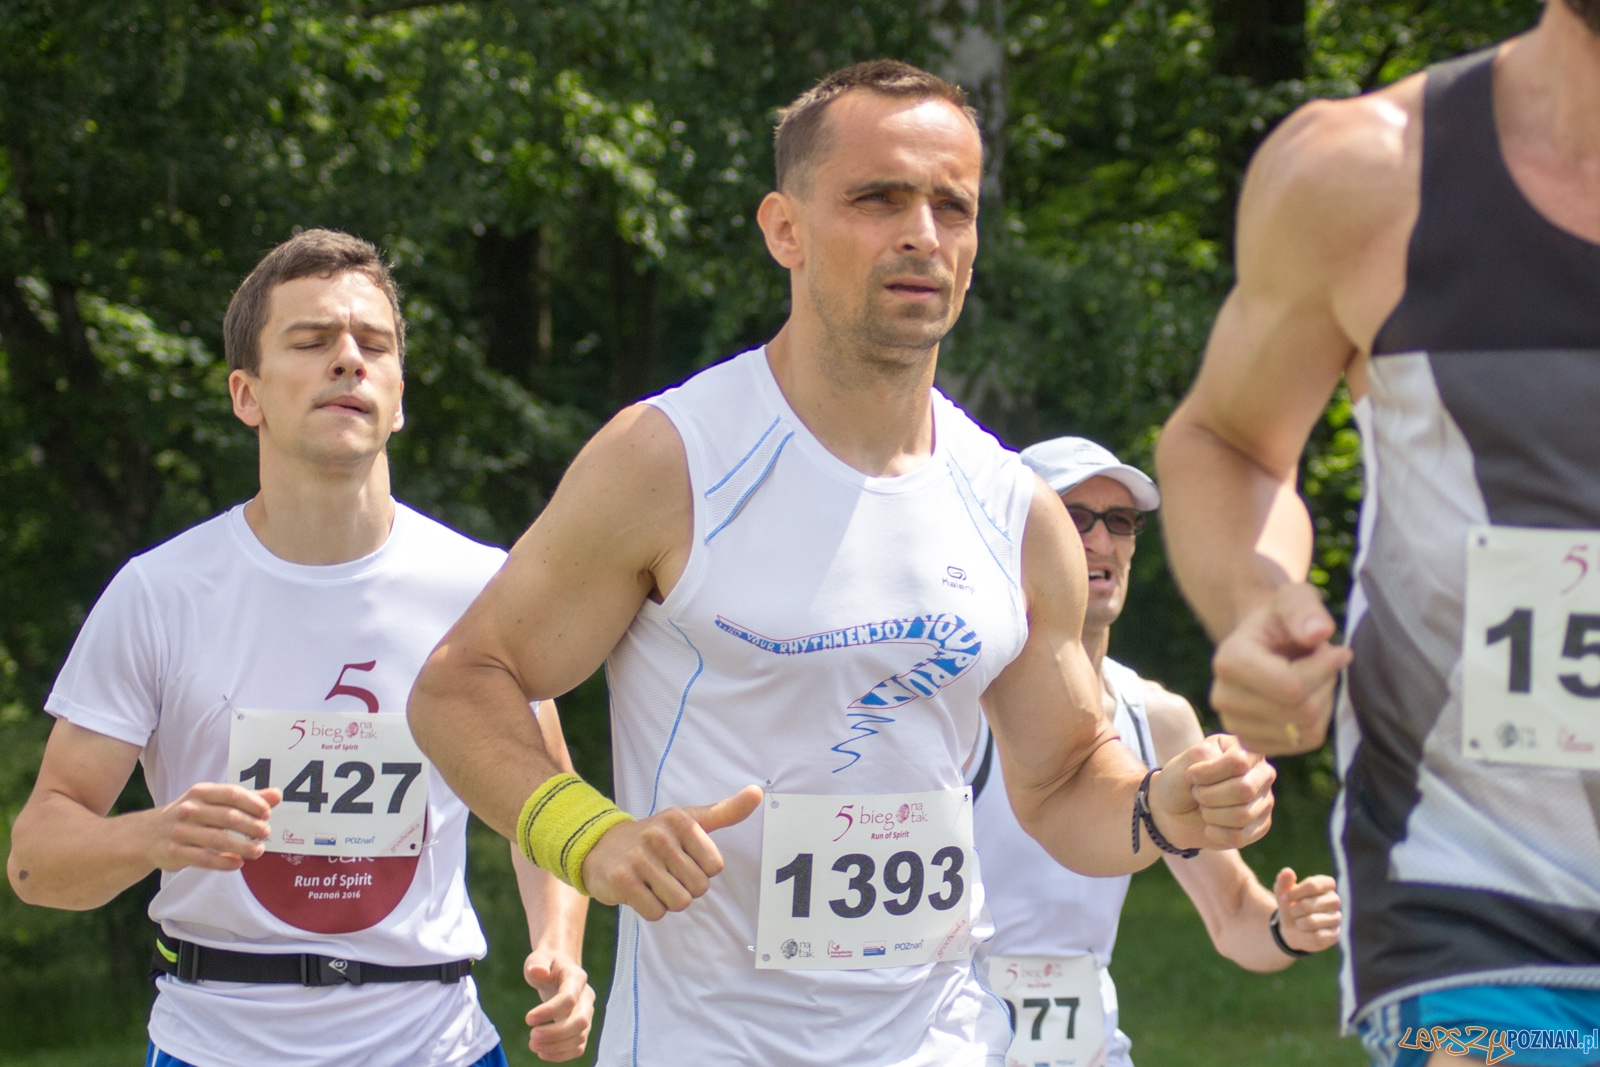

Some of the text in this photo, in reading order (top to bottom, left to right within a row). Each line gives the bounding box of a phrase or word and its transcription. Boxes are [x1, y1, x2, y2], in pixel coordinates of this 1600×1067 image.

[288, 719, 373, 750] 5 bieg na
[360, 729, 378, 739] tak
[342, 743, 359, 751] Spirit
[239, 758, 422, 814] 1427
[833, 803, 923, 842] 5 bieg na
[911, 811, 928, 823] tak
[885, 831, 893, 839] of
[893, 830, 909, 840] Spirit
[295, 873, 373, 889] Run of Spirit
[775, 846, 964, 919] 1393
[308, 890, 361, 899] Poznań 2016
[799, 949, 814, 959] tak
